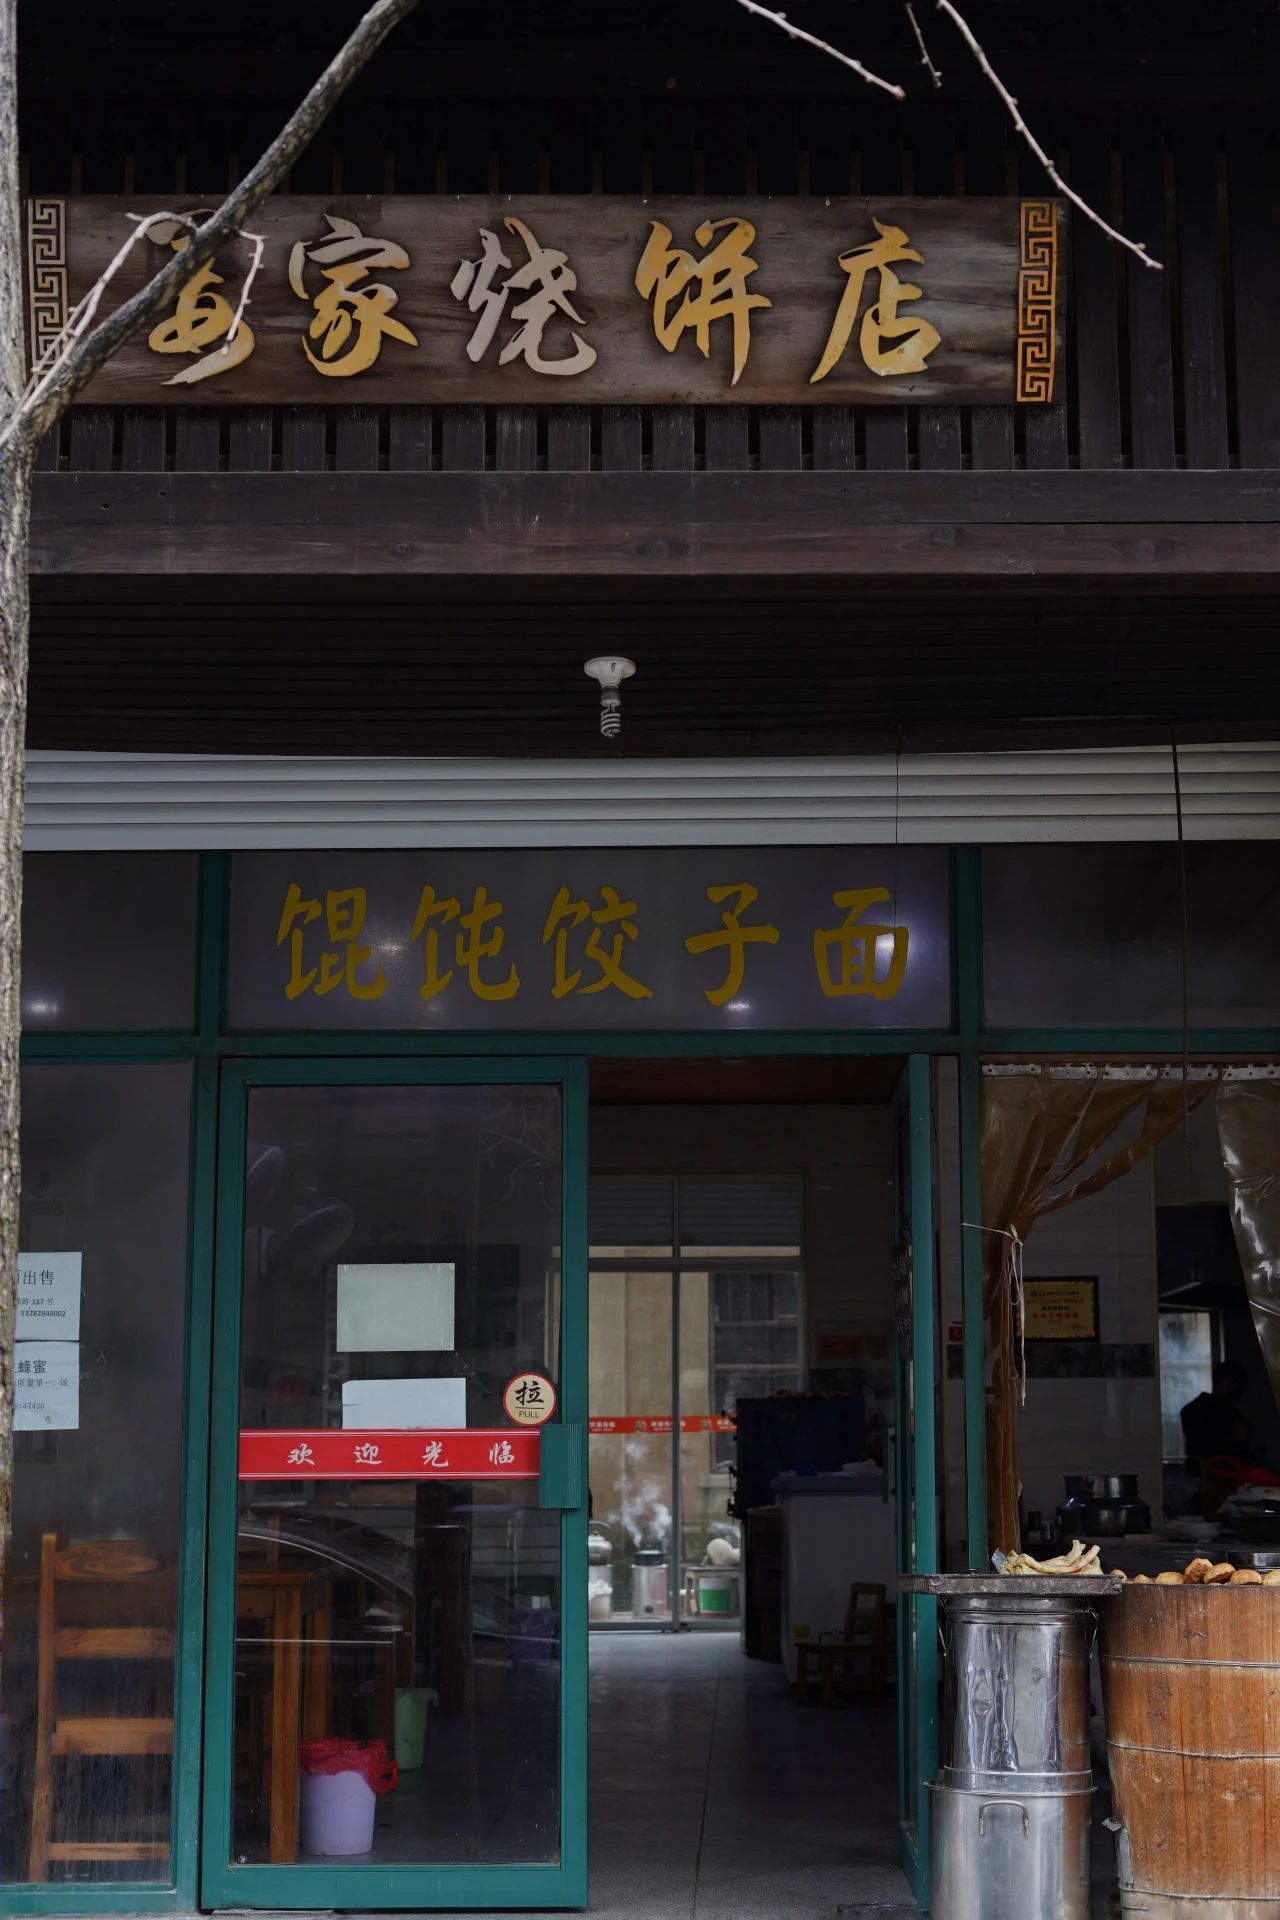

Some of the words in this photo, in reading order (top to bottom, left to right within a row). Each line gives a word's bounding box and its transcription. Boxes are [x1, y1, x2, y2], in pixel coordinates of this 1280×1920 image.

[277, 883, 909, 1006] 馄饨饺子面
[14, 1360, 47, 1374] 蜂蜜
[515, 1381, 544, 1406] 拉
[287, 1440, 515, 1468] 欢迎光临
